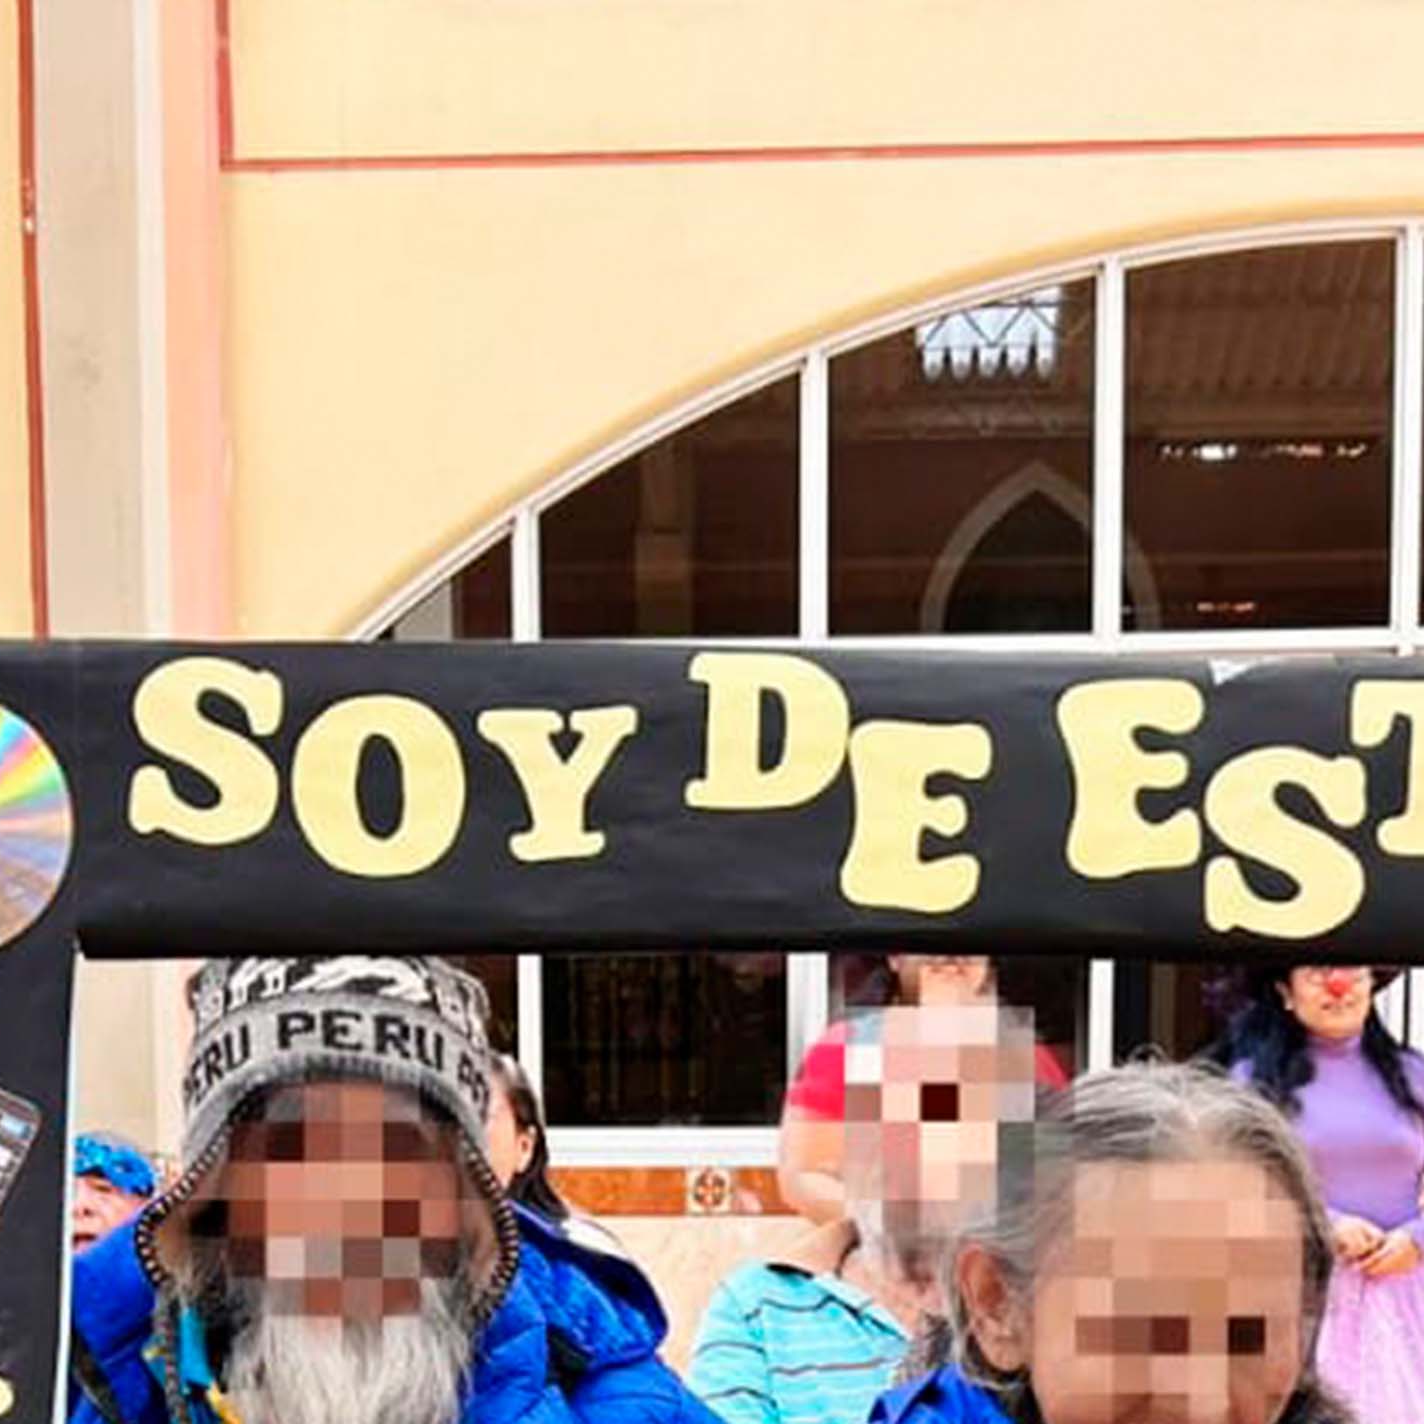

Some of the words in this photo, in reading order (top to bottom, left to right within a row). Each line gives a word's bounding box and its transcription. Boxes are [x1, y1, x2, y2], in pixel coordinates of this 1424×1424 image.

[127, 654, 639, 878] SOY
[683, 651, 993, 913] DE
[276, 1008, 445, 1071] PERU
